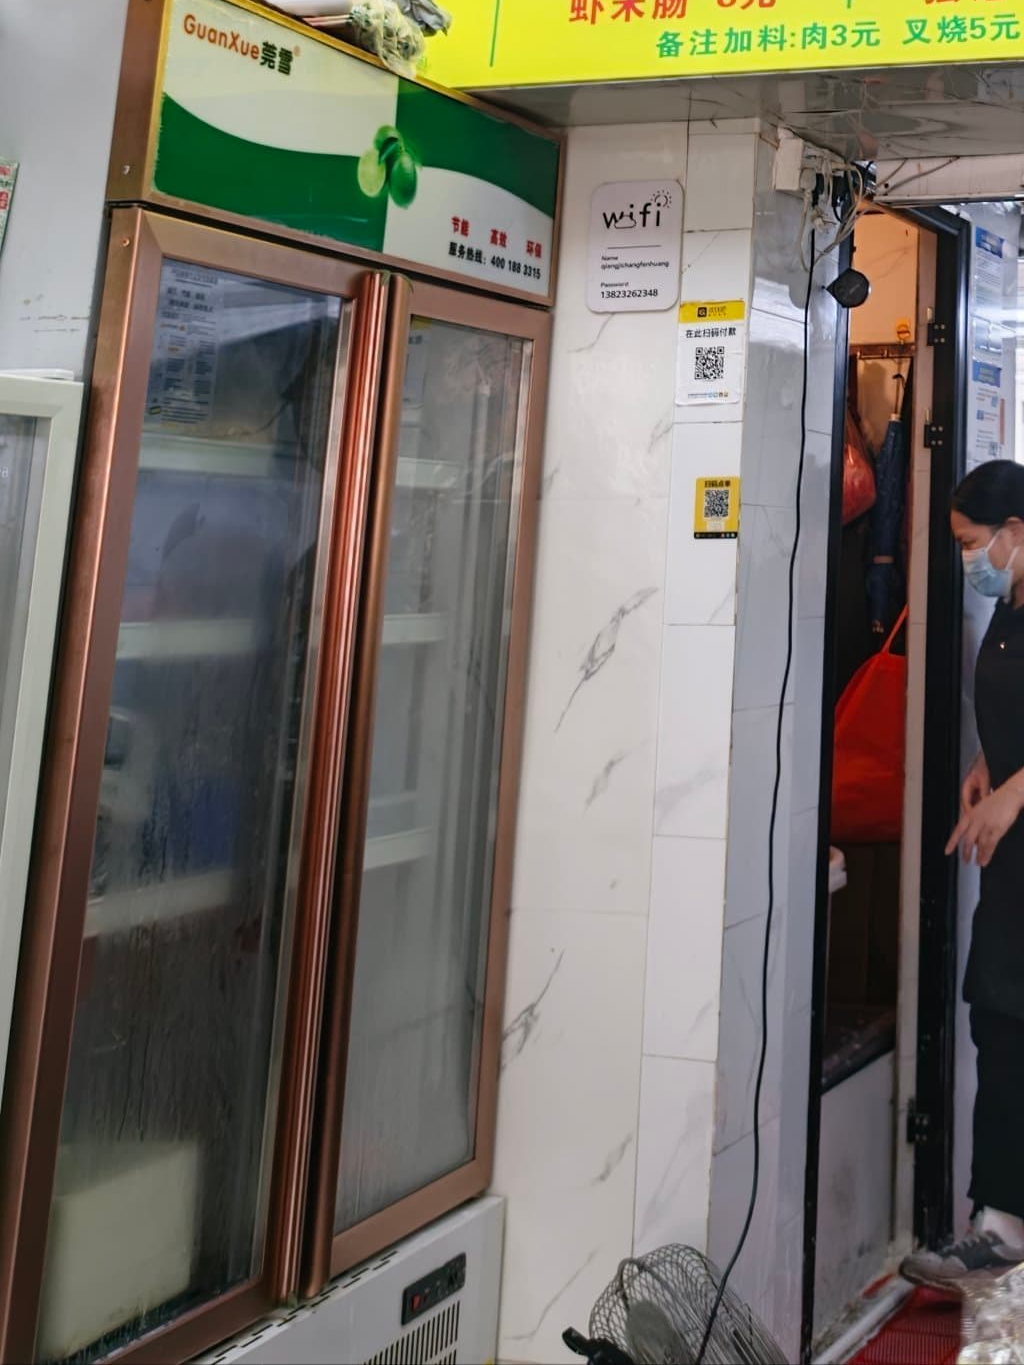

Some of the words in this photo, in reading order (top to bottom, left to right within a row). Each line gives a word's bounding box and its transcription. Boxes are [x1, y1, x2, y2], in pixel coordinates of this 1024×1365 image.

[901, 13, 1021, 46] 叉烧5元
[600, 288, 659, 299] 13823262348
